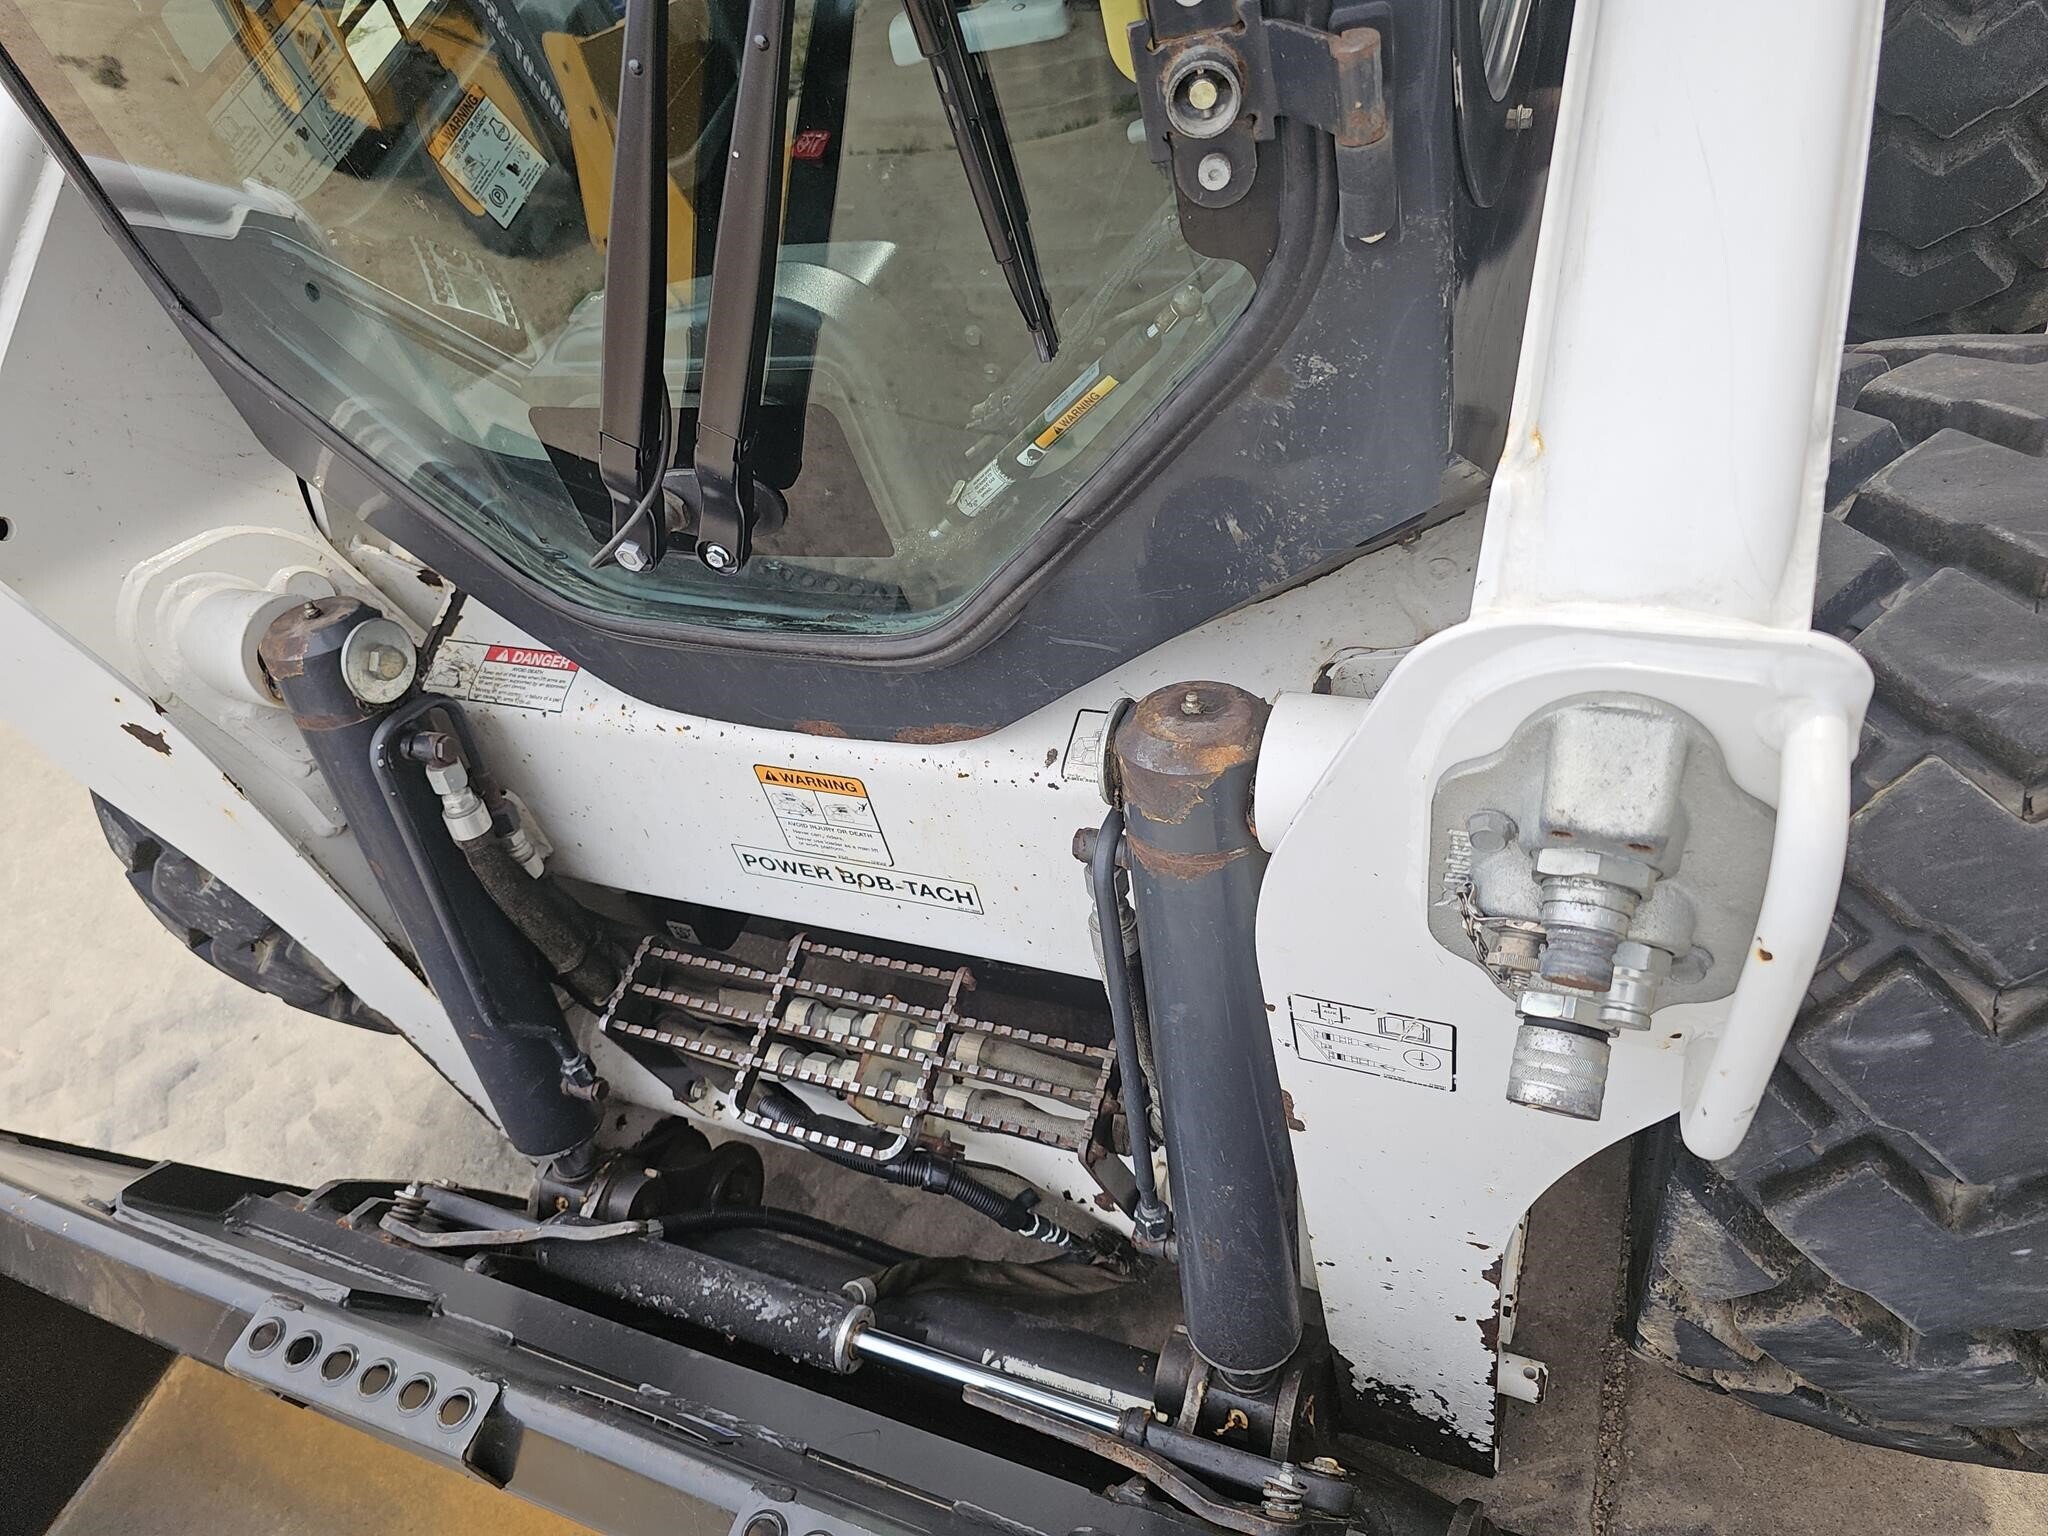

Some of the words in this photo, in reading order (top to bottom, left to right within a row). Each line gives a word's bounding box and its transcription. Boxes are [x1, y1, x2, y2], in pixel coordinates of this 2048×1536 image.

[444, 94, 478, 140] WARNING
[1059, 392, 1101, 427] WARNING
[512, 651, 570, 669] DANGER
[779, 772, 858, 793] WARNING
[788, 821, 809, 829] AVOID
[810, 824, 836, 833] INJURY
[837, 827, 848, 835] OR
[849, 829, 873, 839] DEATH
[742, 853, 833, 881] POWER
[838, 867, 974, 905] BOB-TACH
